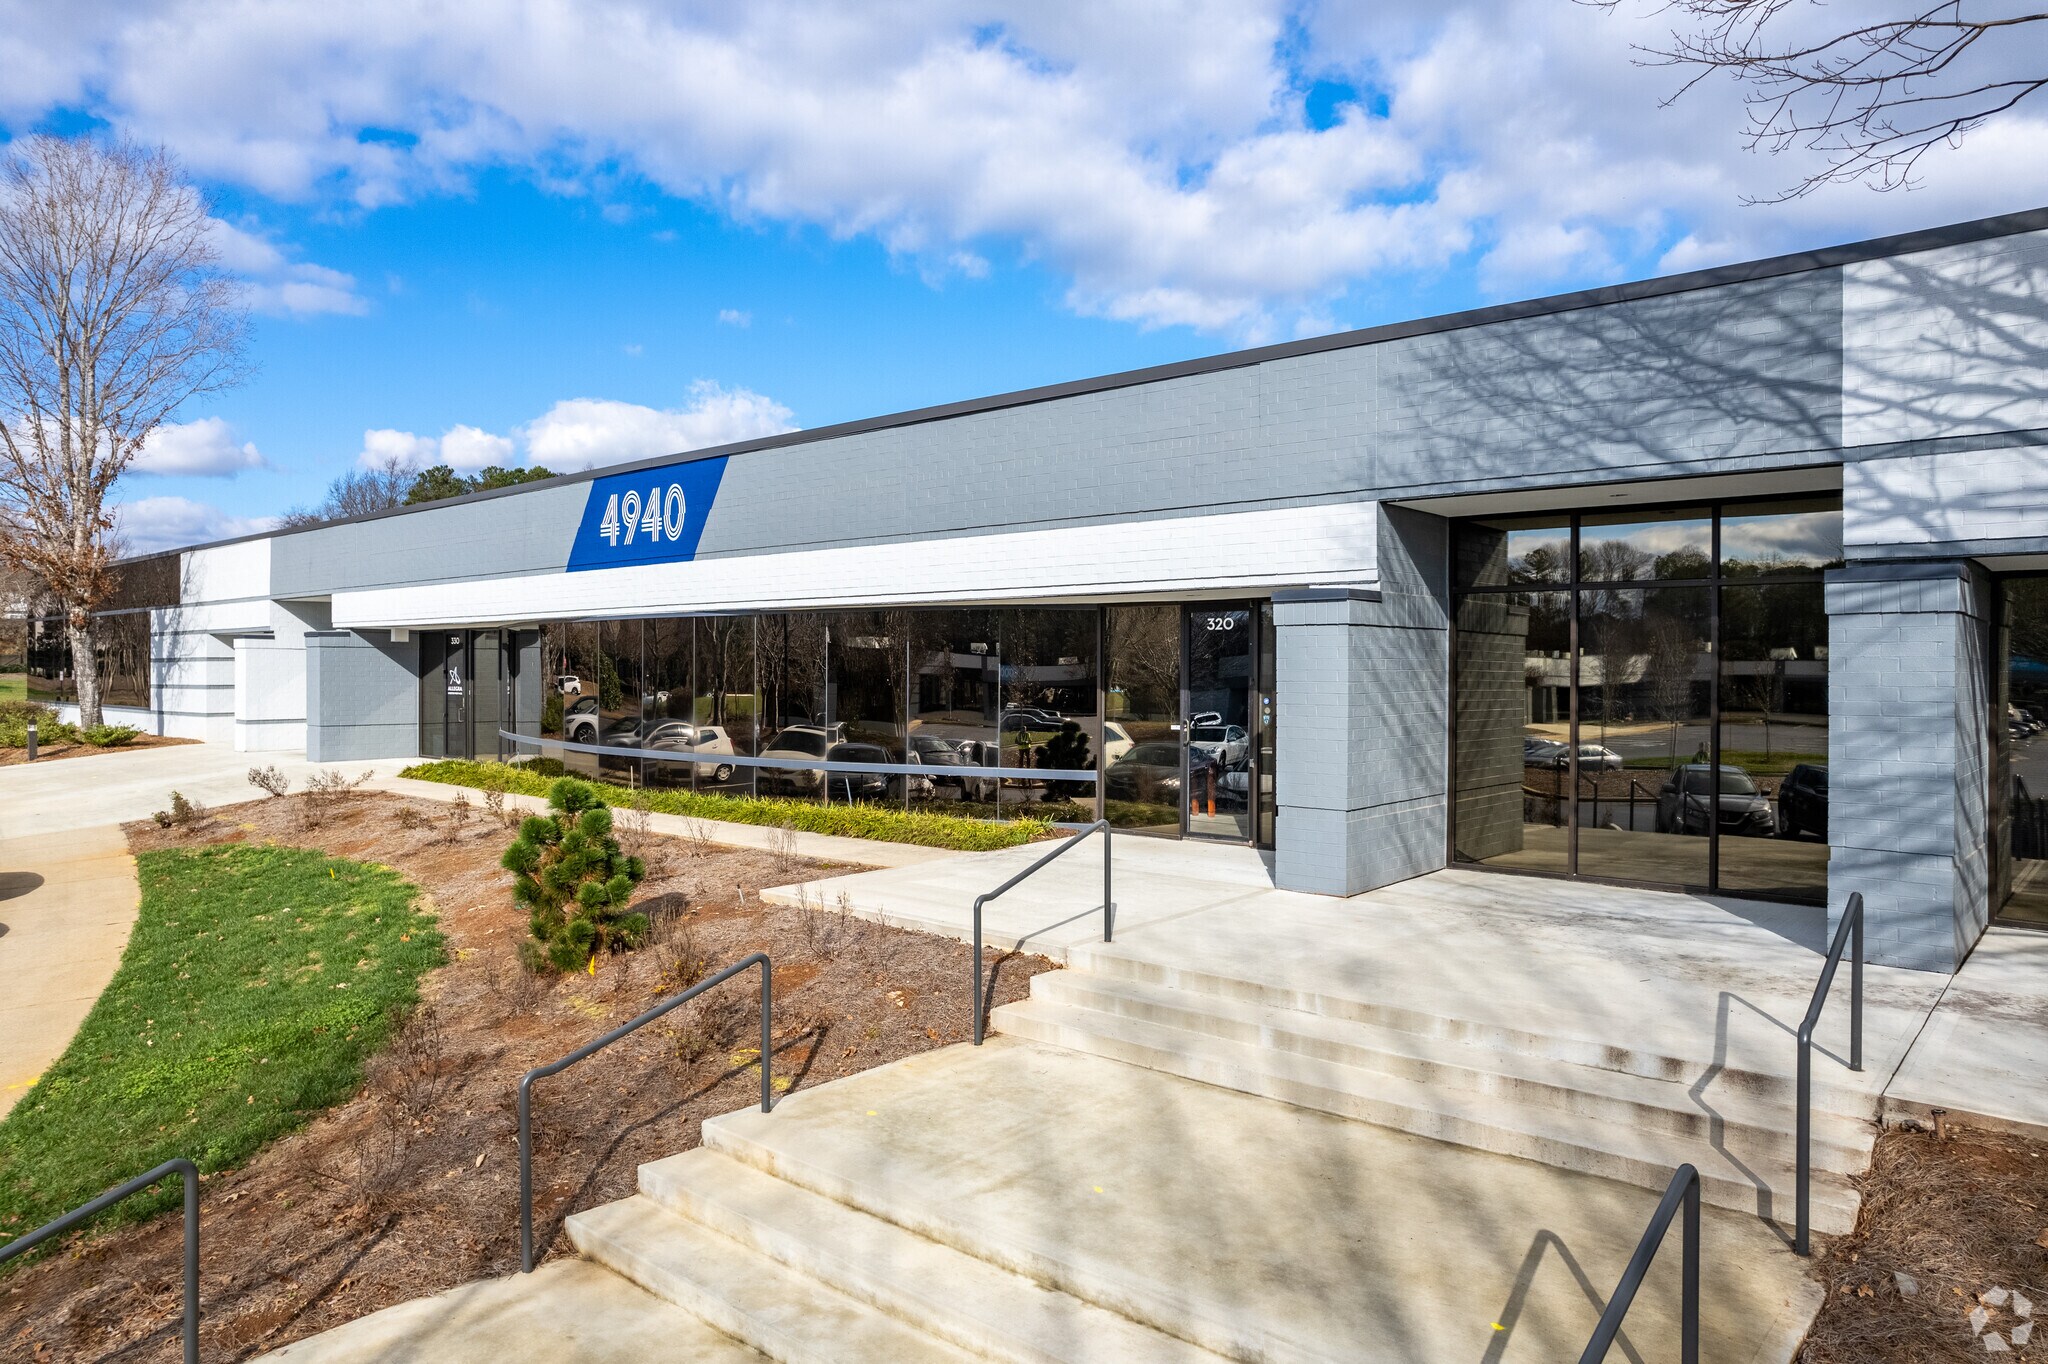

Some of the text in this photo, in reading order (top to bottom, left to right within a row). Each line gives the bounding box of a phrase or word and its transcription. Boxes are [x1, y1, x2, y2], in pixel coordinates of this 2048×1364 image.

[601, 483, 686, 547] 4940
[1207, 617, 1234, 630] 320
[451, 637, 460, 645] 330
